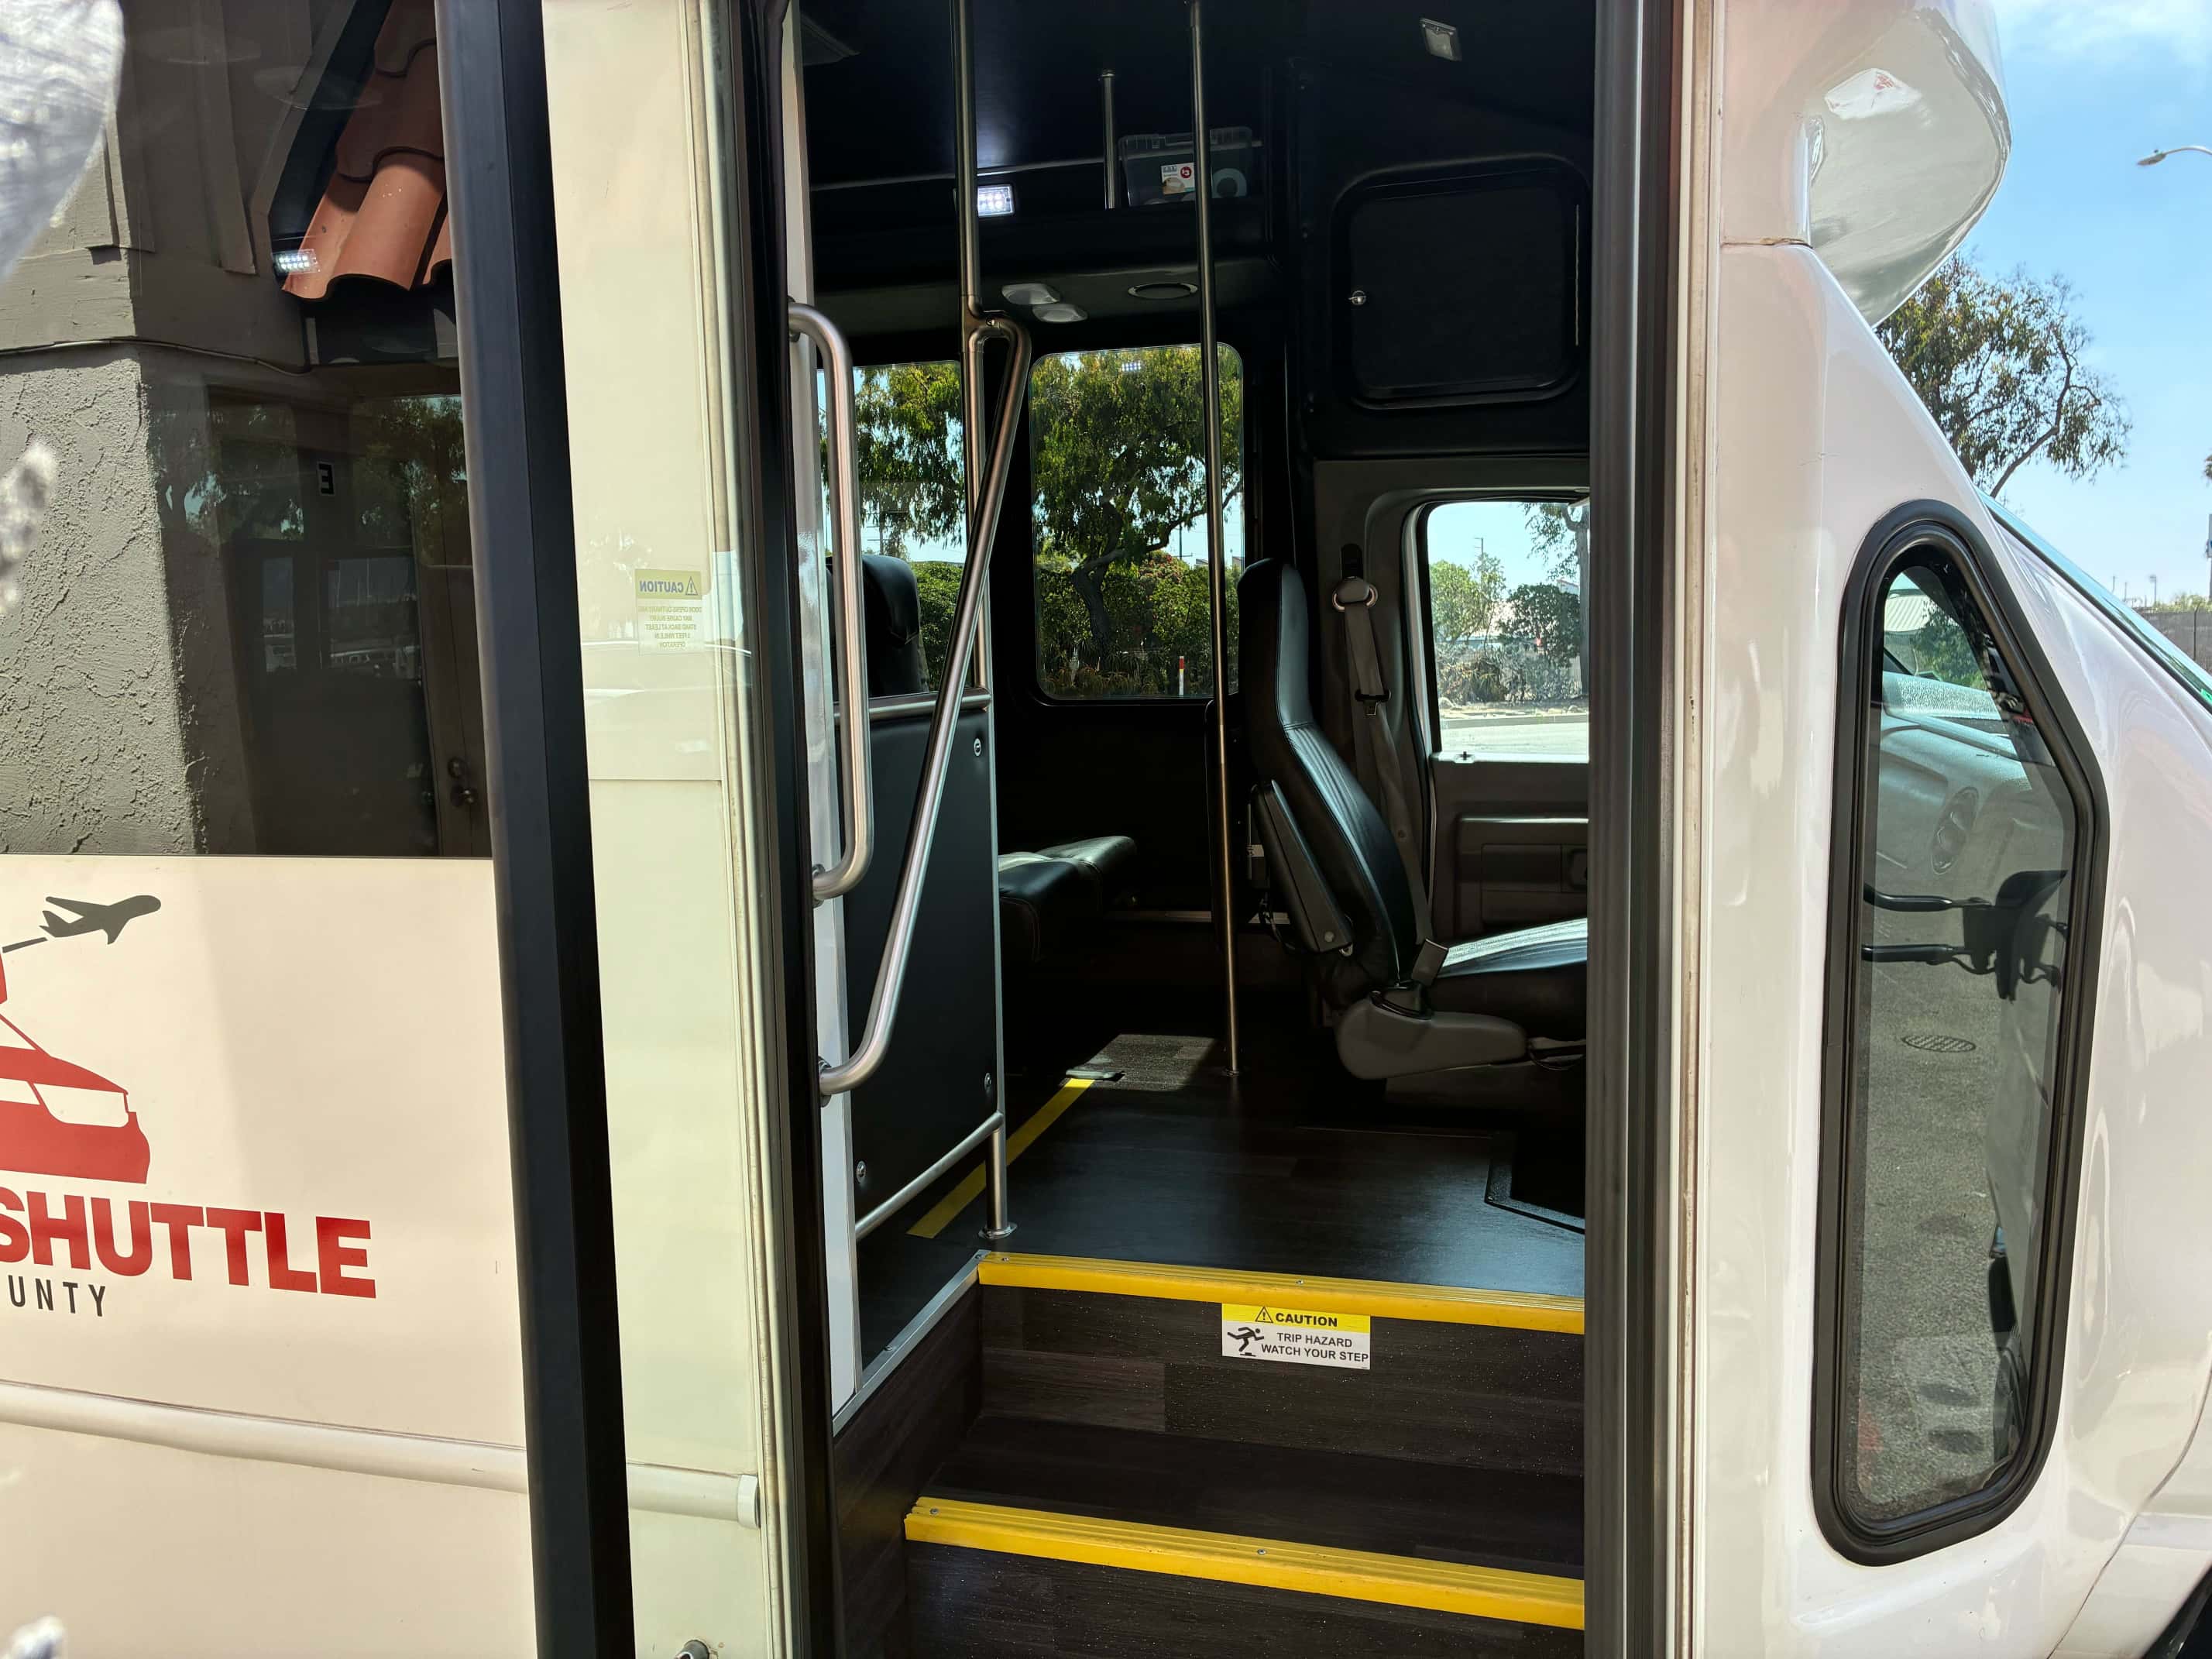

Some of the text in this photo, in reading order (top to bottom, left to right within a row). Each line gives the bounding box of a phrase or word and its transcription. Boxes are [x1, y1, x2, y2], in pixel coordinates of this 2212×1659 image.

[1275, 1312, 1338, 1327] CAUTION
[1276, 1332, 1352, 1348] TRIP HAZARD
[1261, 1344, 1369, 1362] WATCH YOUR STEP
